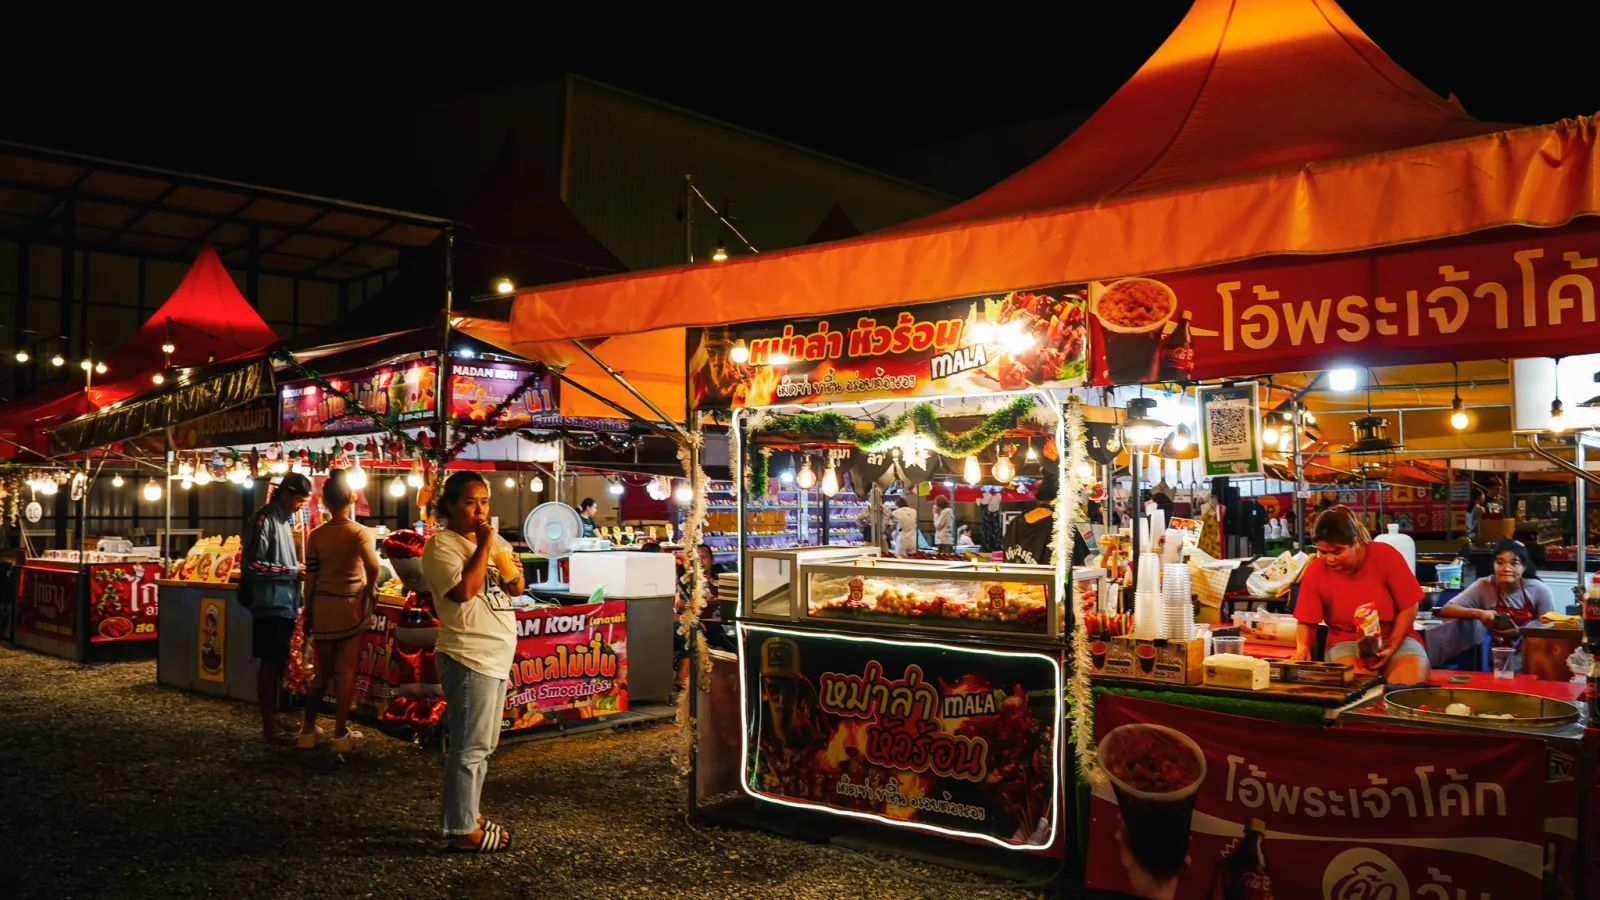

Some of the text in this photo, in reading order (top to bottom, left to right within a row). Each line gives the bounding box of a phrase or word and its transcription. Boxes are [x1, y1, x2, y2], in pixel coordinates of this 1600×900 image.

[848, 311, 963, 357] หัวร้อน
[452, 365, 494, 378] MADAM
[532, 414, 563, 428] Fruit
[545, 614, 586, 634] KOH
[505, 689, 536, 709] Fruit
[824, 667, 933, 721] หม่าล่า
[869, 717, 982, 776] หัวร้อน
[1226, 754, 1507, 818] โอ้พระเจ้าโค้ก
